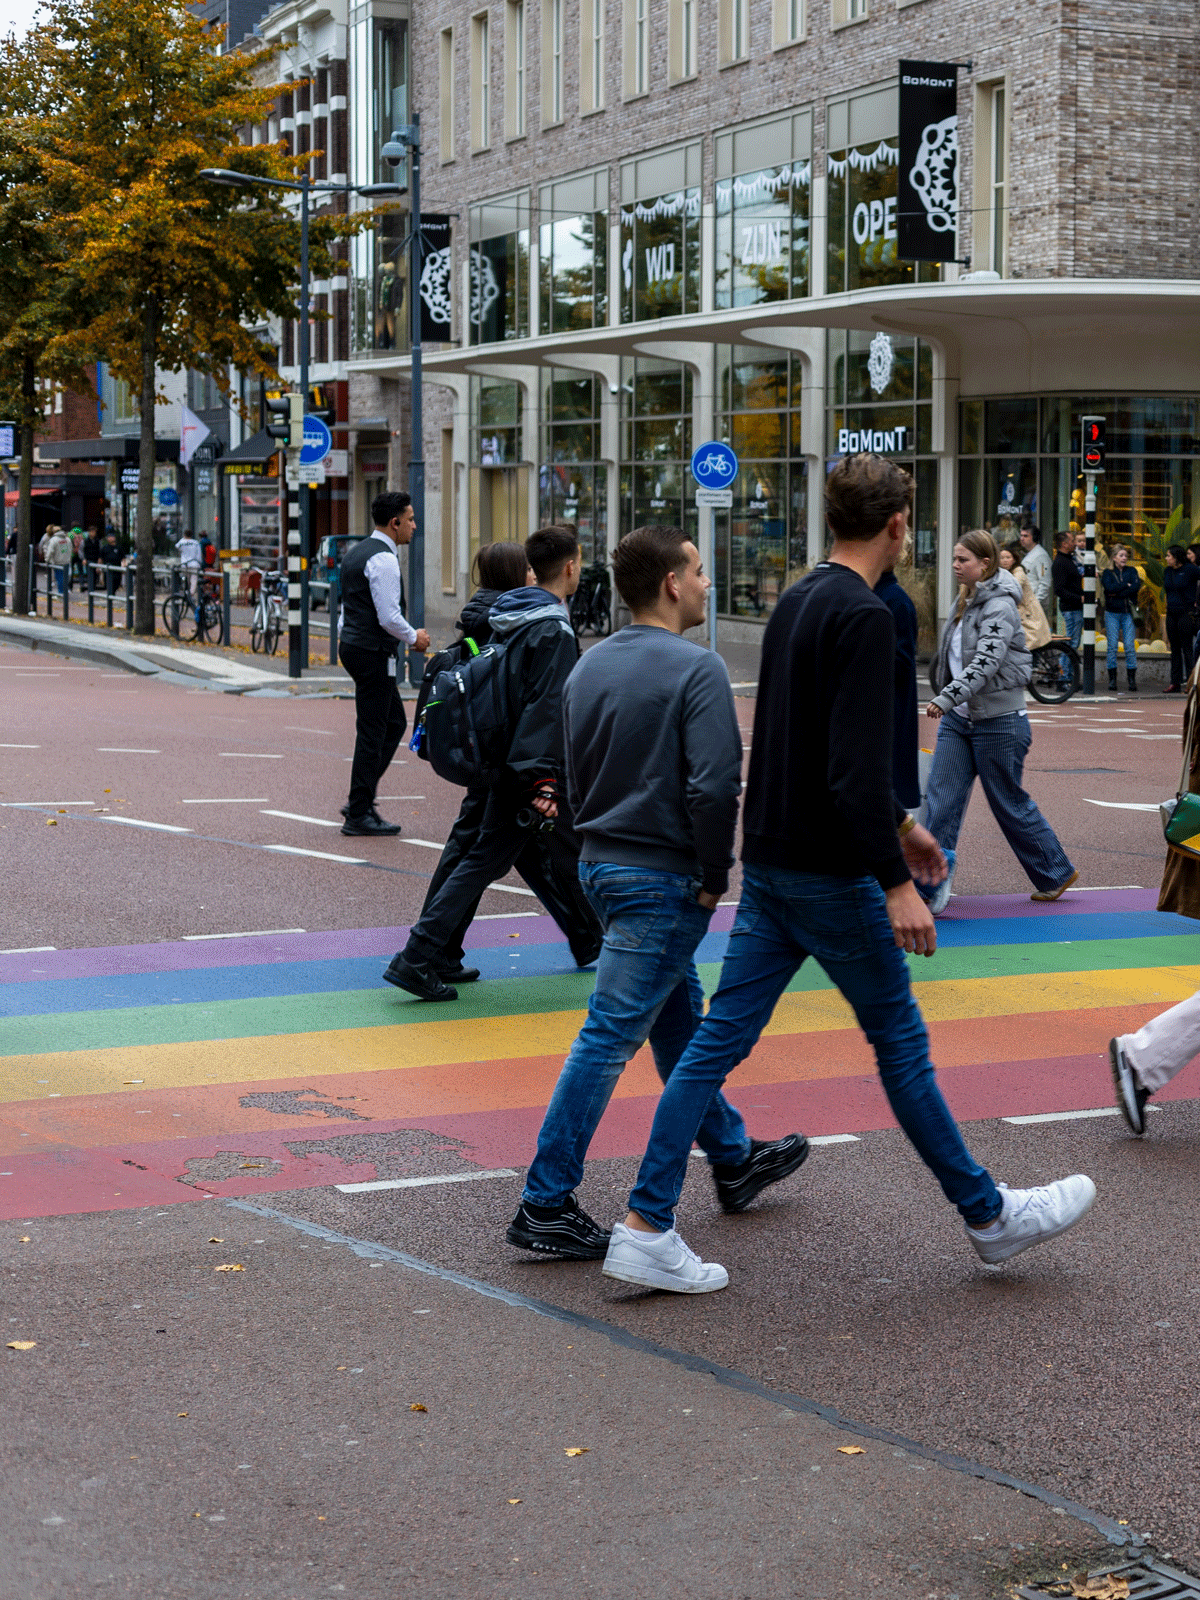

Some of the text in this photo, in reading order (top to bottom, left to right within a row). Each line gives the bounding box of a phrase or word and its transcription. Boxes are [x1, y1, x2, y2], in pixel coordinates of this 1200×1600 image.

[645, 197, 897, 283] WIJ ZIJN OPE
